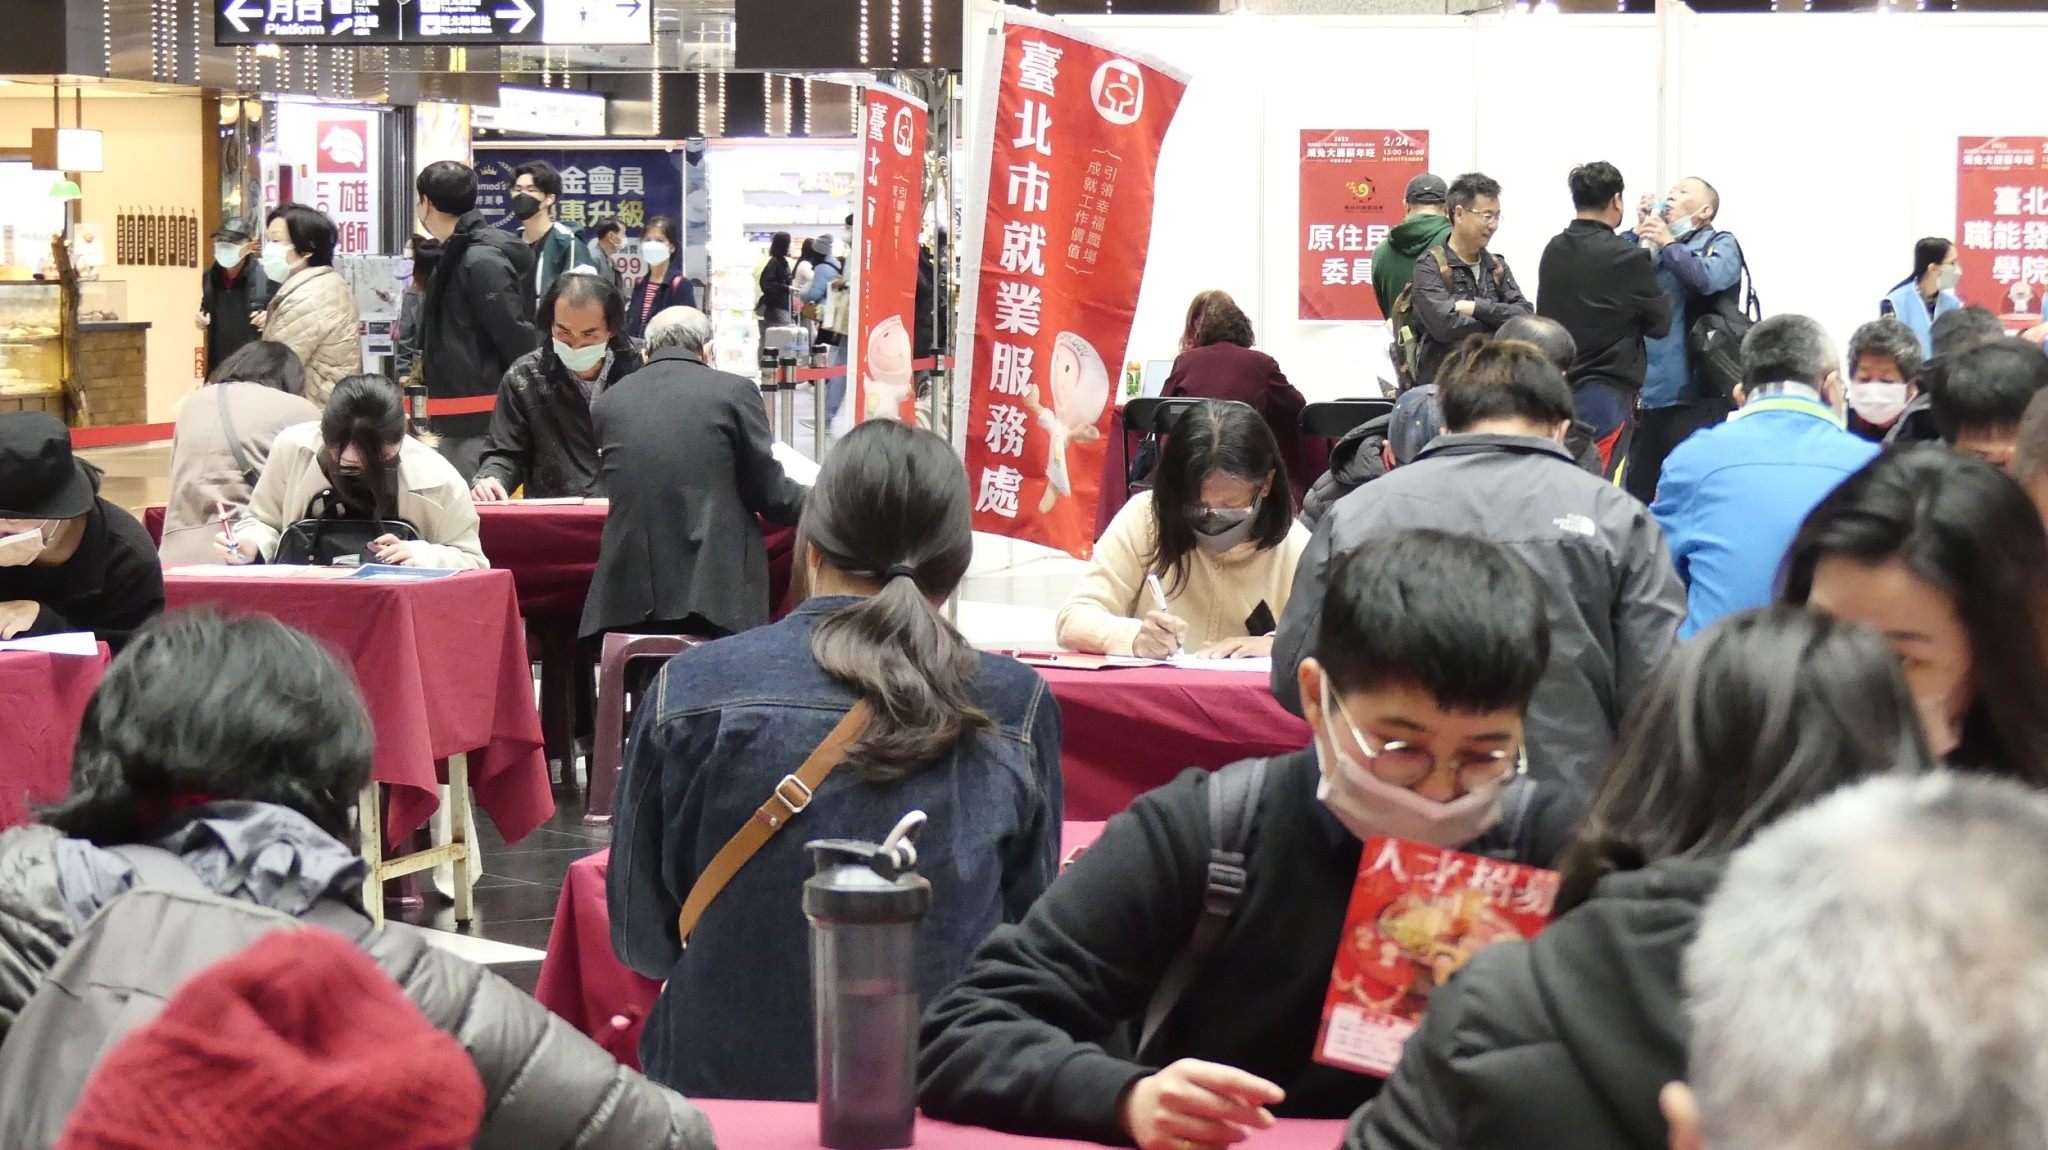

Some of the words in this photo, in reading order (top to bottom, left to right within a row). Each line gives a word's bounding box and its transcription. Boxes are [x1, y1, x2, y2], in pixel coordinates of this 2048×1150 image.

[265, 24, 325, 35] Platform
[1383, 135, 1409, 147] 2/24
[558, 166, 645, 196] 金會員
[548, 200, 645, 228] 惠升級
[1068, 161, 1101, 260] 成就工作價值
[1083, 166, 1117, 265] 引領幸福職場
[1993, 186, 2048, 216] 臺北
[338, 180, 368, 254] 雄獅
[1307, 224, 1389, 251] 原住民
[1963, 220, 2048, 250] 職能發
[975, 40, 1063, 518] 臺北市就業服務處
[1321, 257, 1373, 285] 委員
[1992, 255, 2048, 284] 學院
